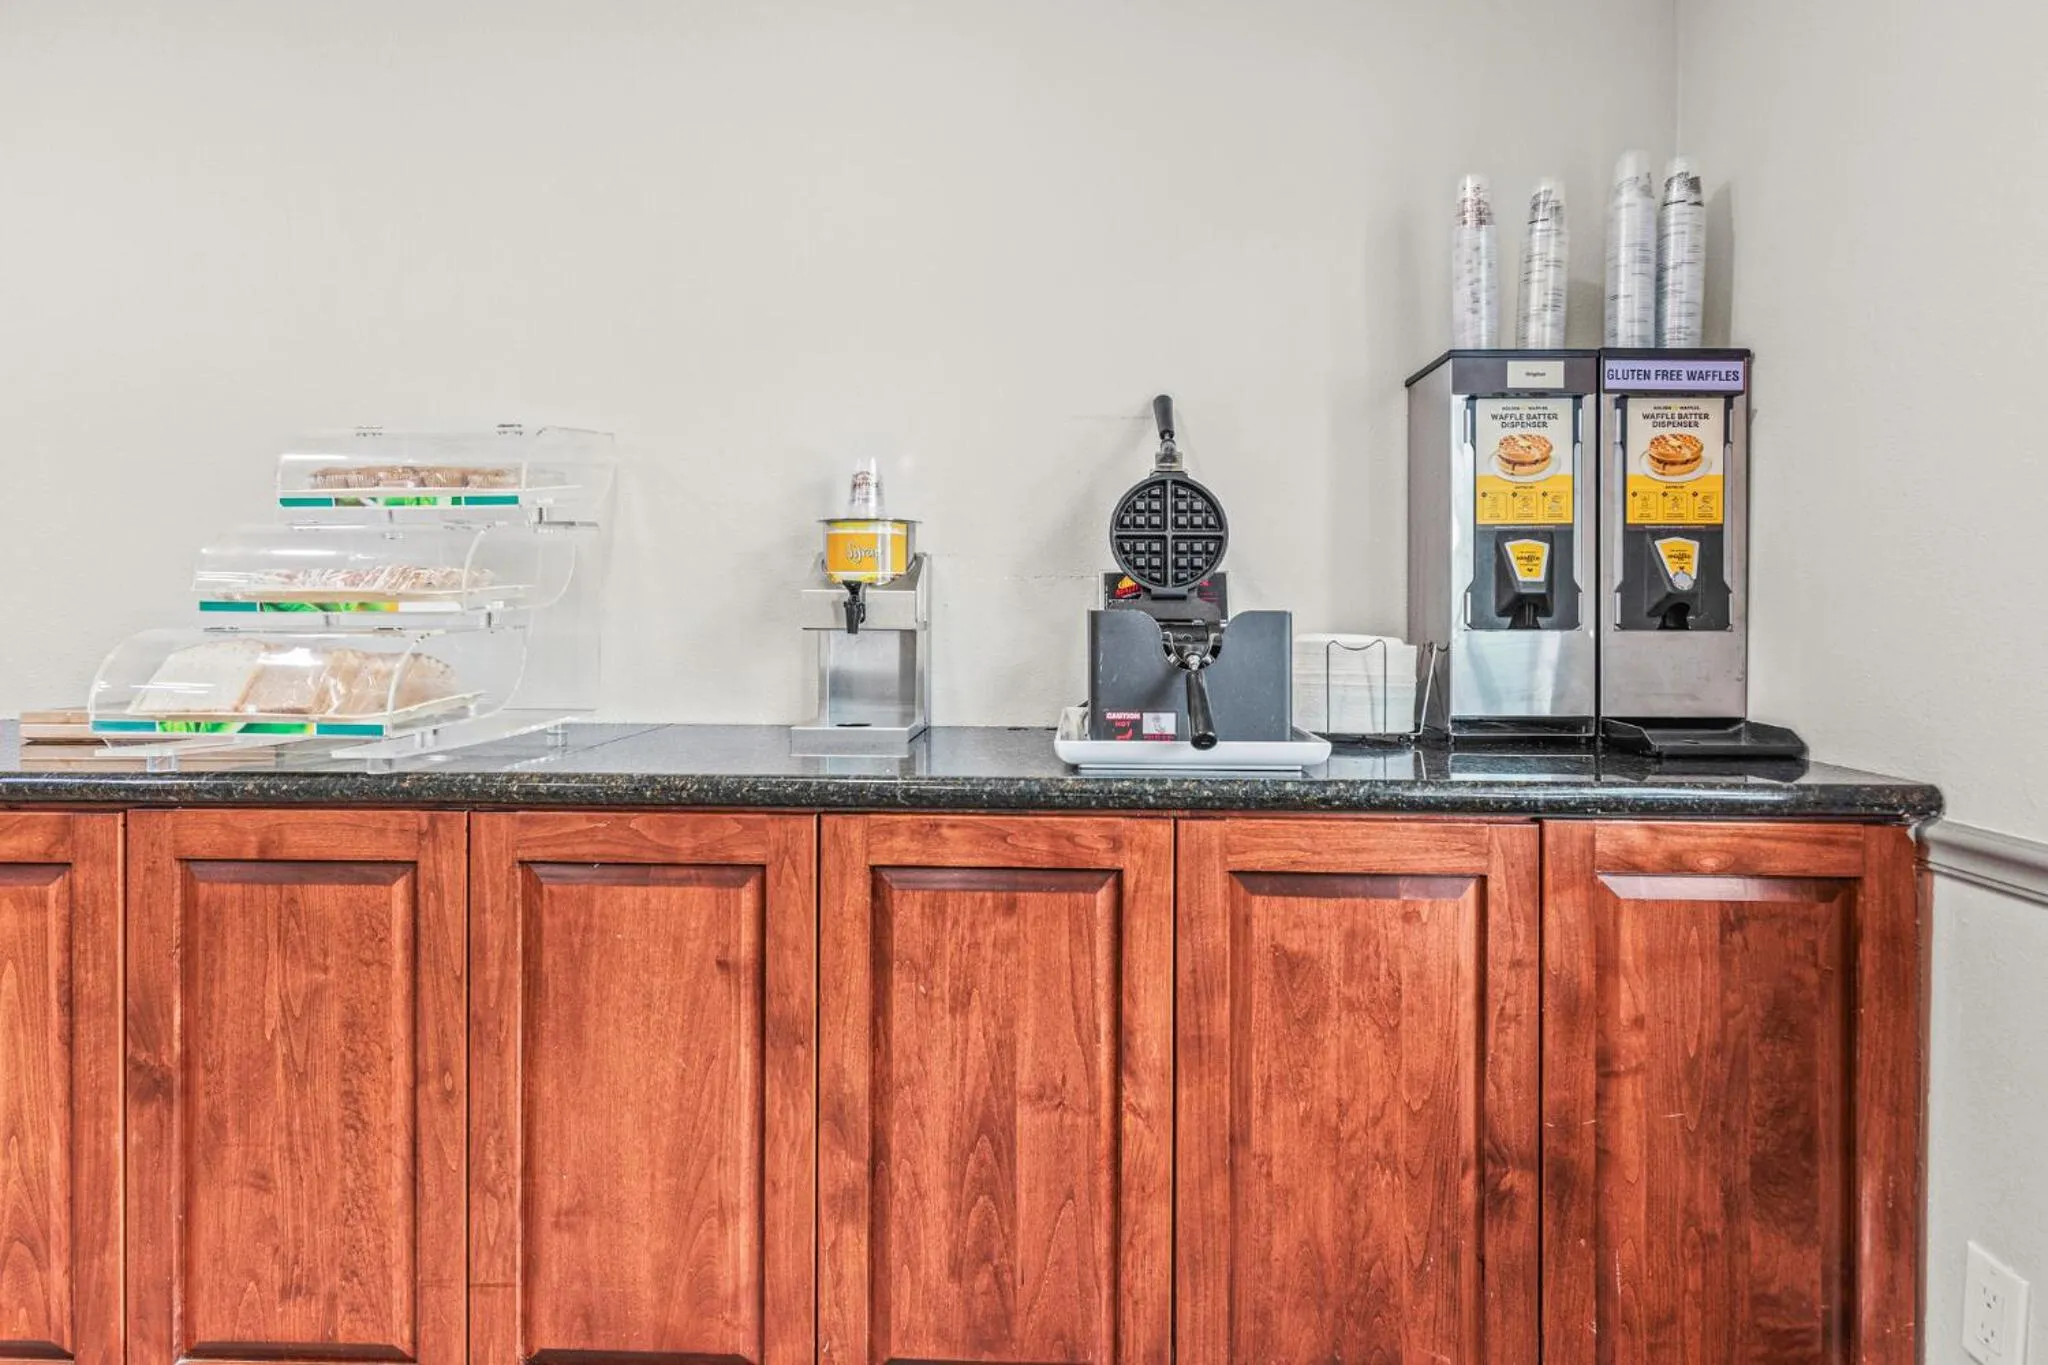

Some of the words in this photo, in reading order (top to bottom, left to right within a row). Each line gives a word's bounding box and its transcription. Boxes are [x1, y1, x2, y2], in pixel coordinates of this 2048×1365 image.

[1606, 369, 1651, 381] GLUTEN
[1655, 369, 1683, 381] FREE
[1686, 370, 1740, 382] WAFFLES
[1490, 413, 1525, 421] WAFFLE
[1526, 413, 1559, 421] BATTER
[1642, 412, 1676, 420] WAFFLE
[1677, 413, 1710, 421] BATTER
[1500, 421, 1549, 429] DISPENSER
[1651, 420, 1699, 428] DISPENSER
[1105, 711, 1141, 720] CAUTION
